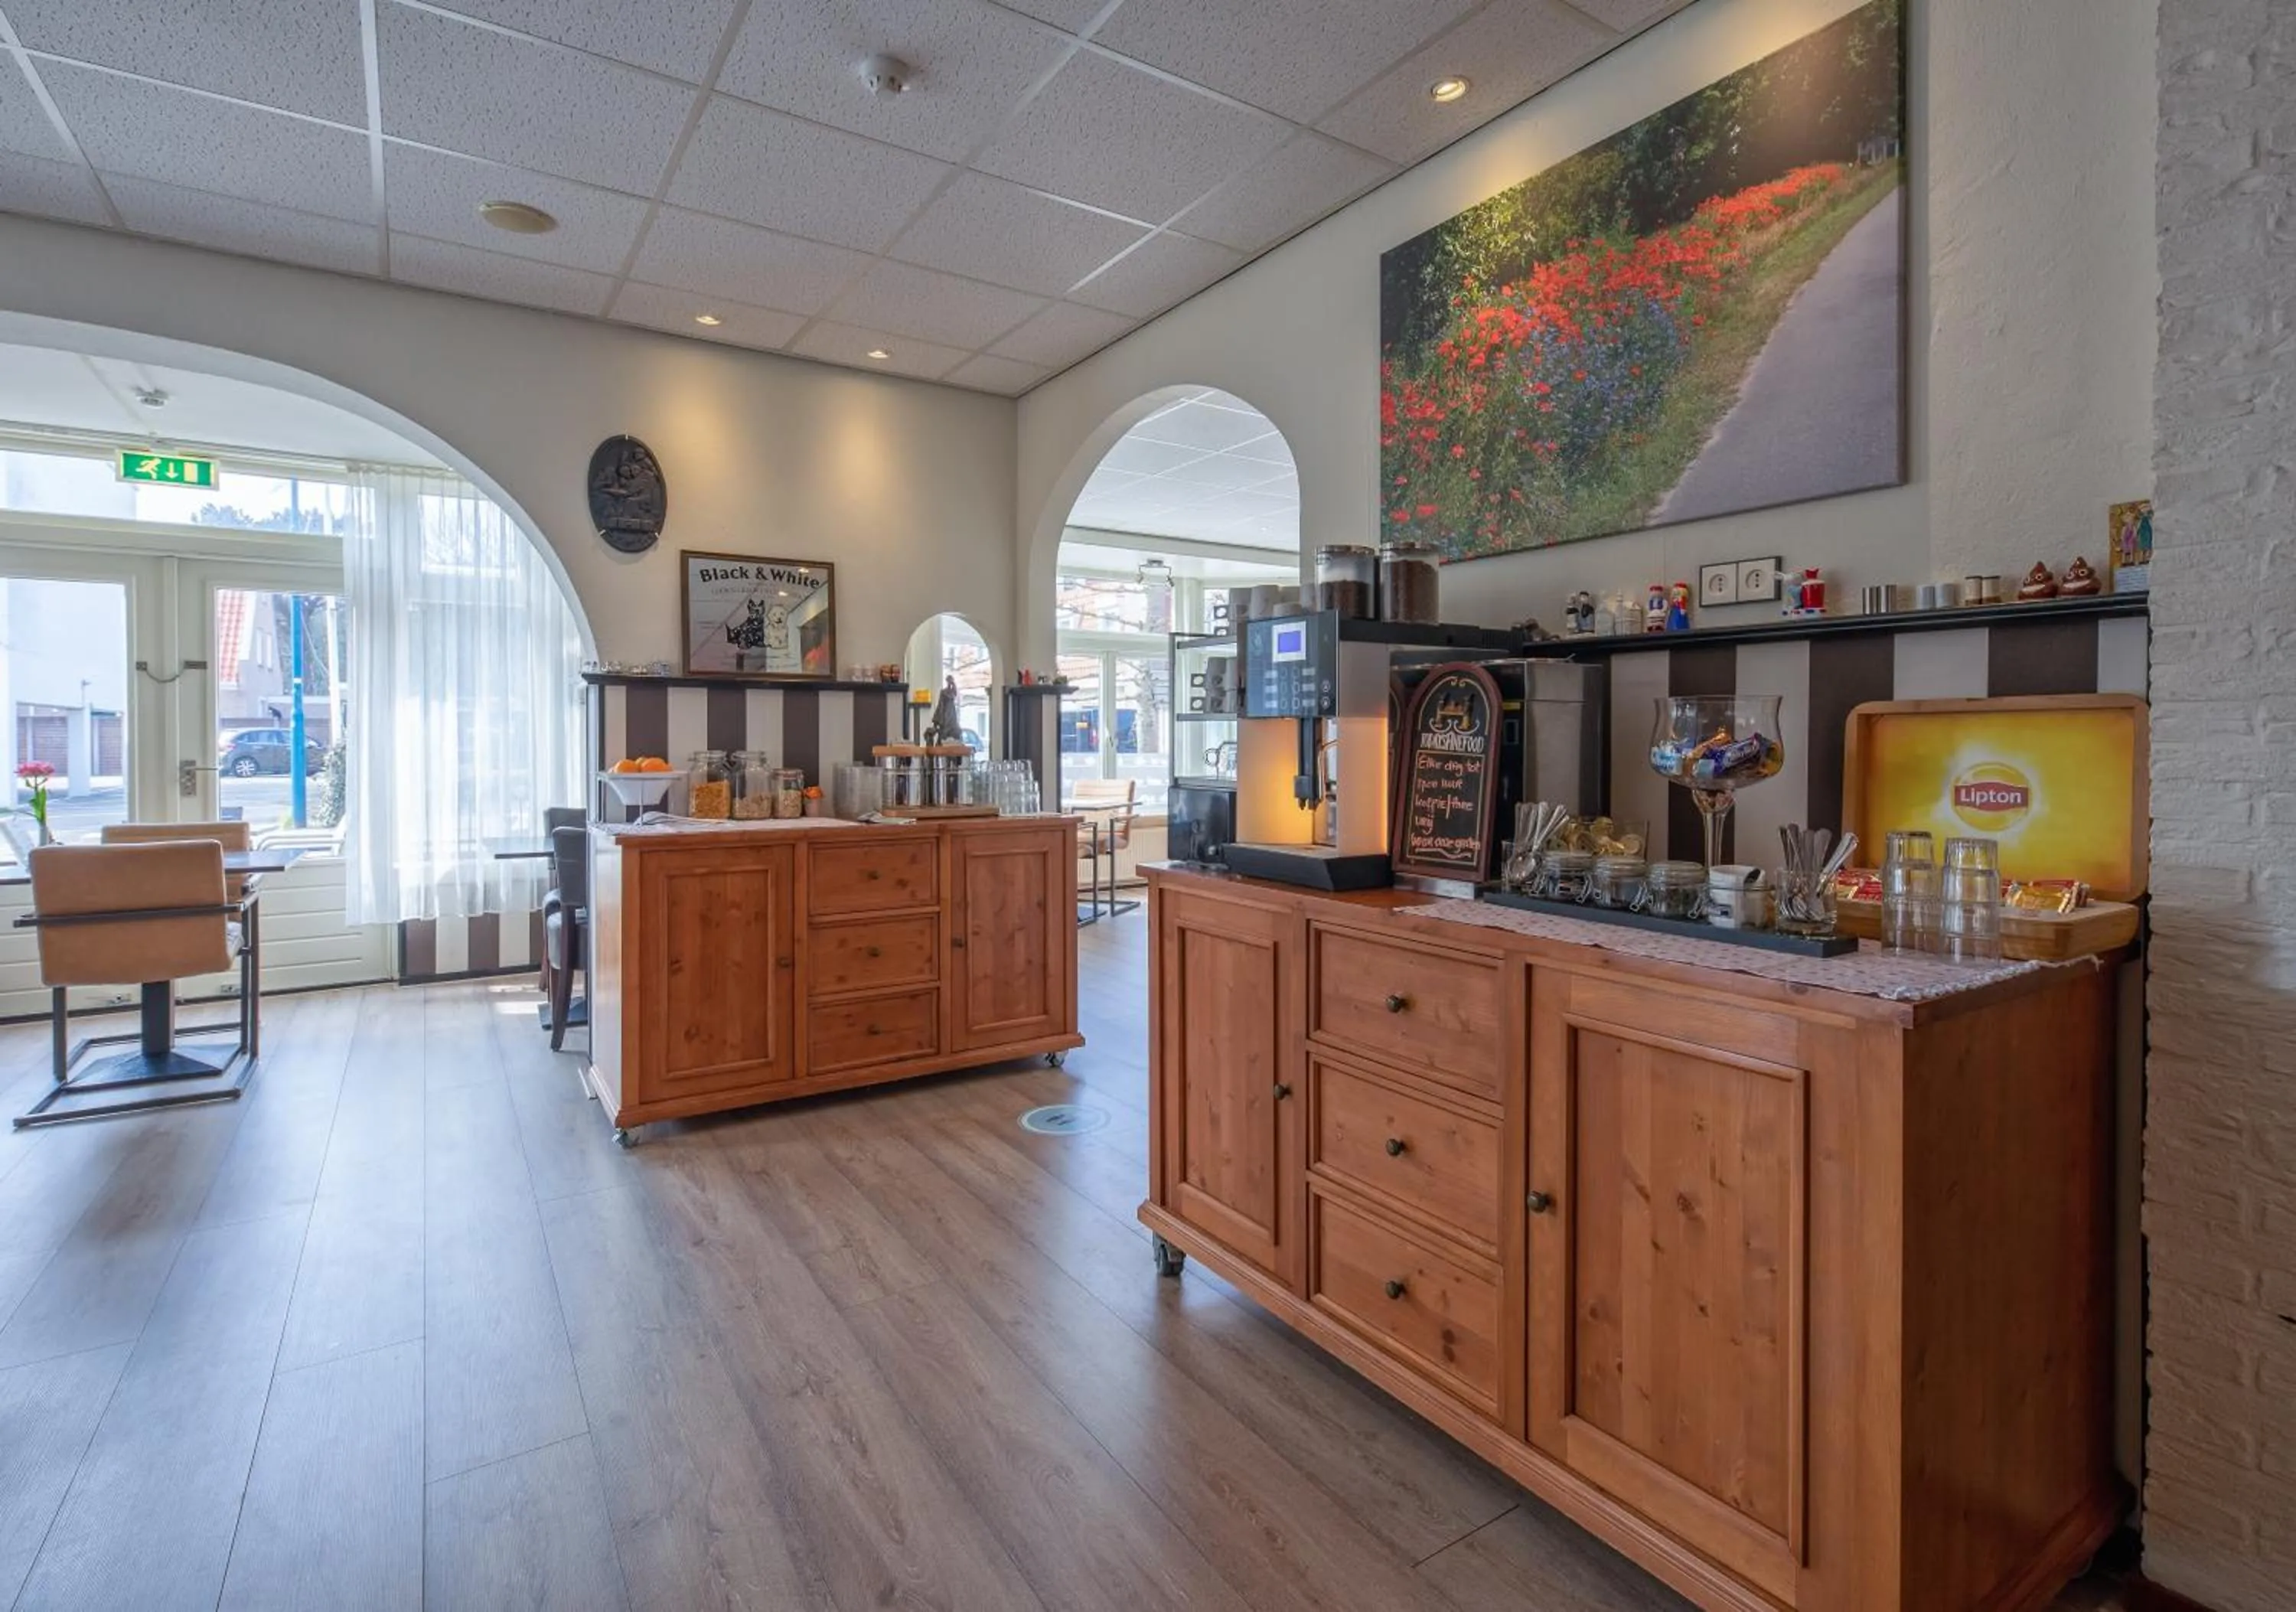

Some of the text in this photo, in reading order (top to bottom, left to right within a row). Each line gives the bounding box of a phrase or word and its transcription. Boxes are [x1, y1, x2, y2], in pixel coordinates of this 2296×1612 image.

[700, 566, 820, 589] Black & White
[1960, 788, 2021, 807] Lipton
